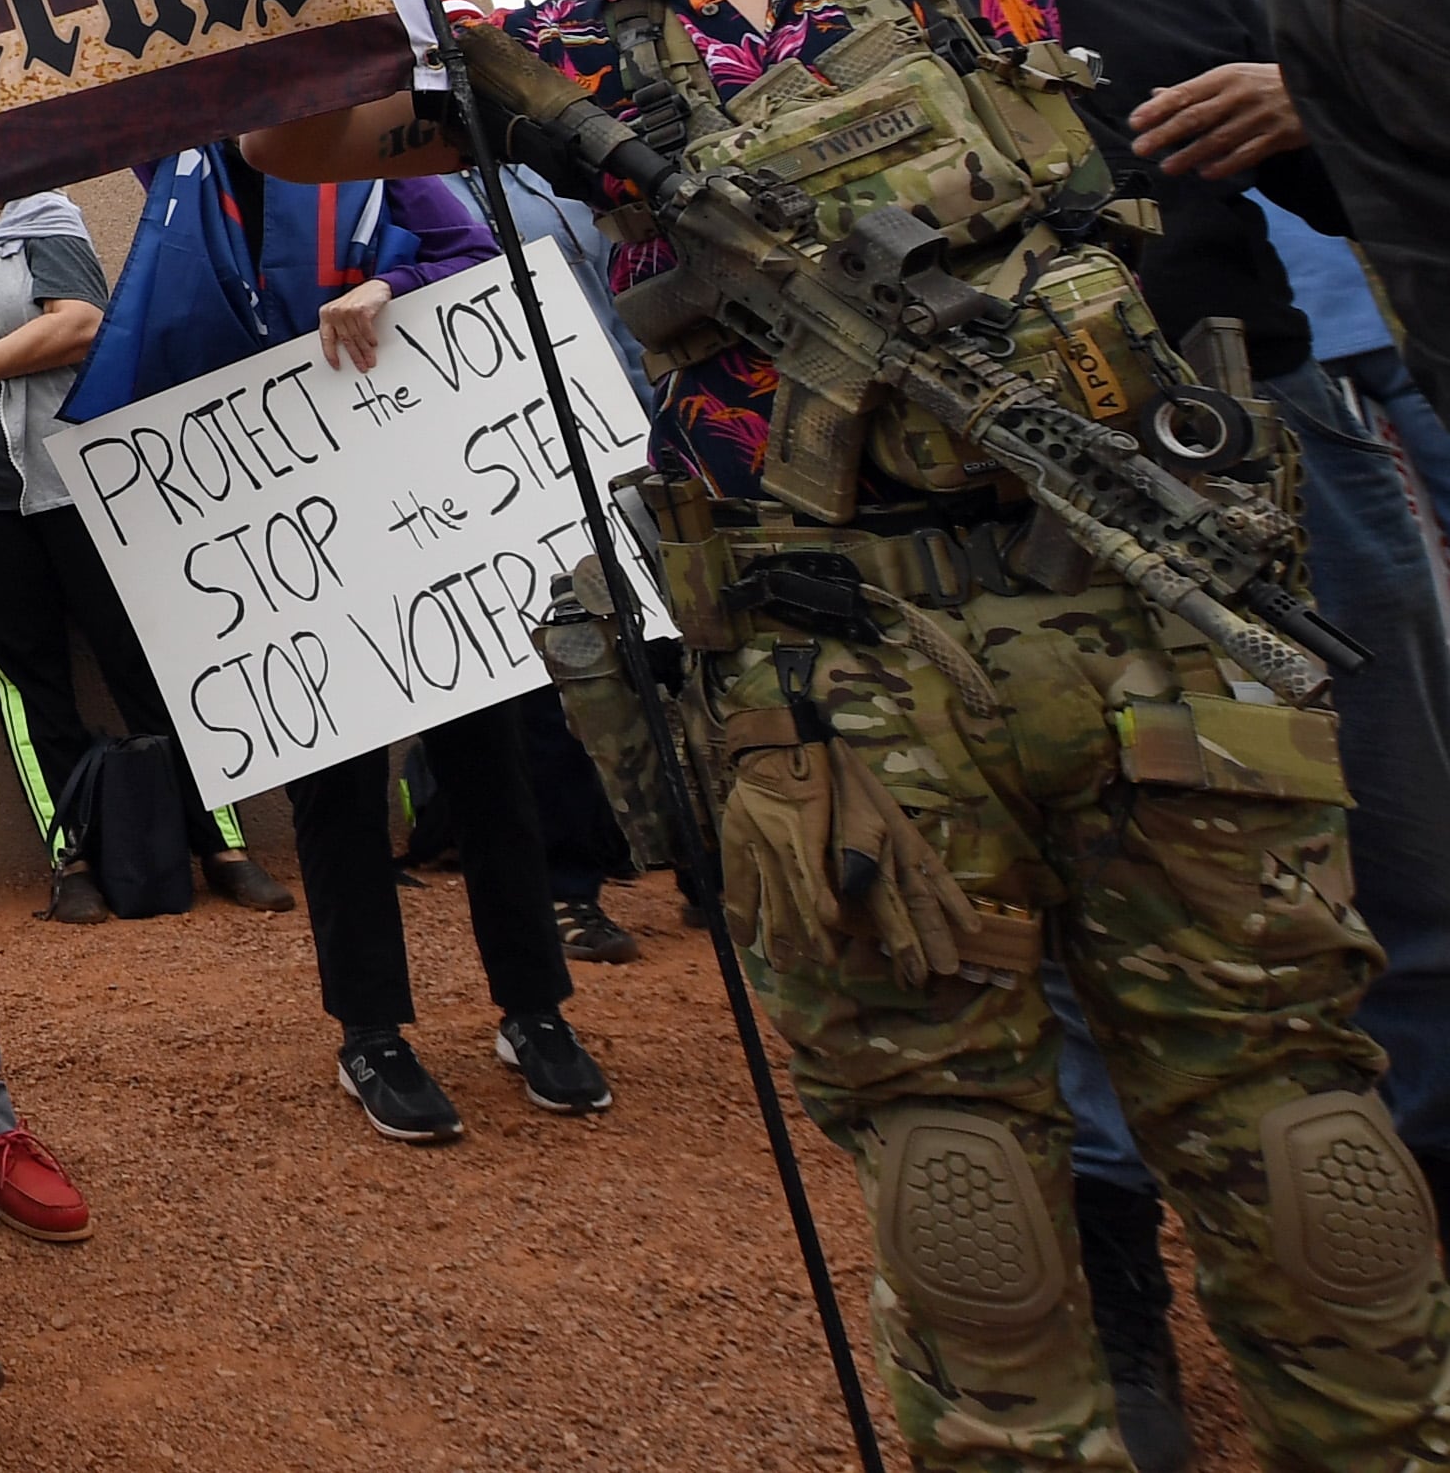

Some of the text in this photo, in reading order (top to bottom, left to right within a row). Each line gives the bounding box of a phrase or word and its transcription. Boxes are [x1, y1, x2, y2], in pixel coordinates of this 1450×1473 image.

[808, 110, 914, 162] TWITCH
[79, 362, 340, 546] PROTECT
[352, 378, 421, 428] the
[183, 495, 344, 639] STOP
[388, 490, 468, 550] the
[190, 630, 339, 779] STOP
[347, 551, 547, 704] VOTER
